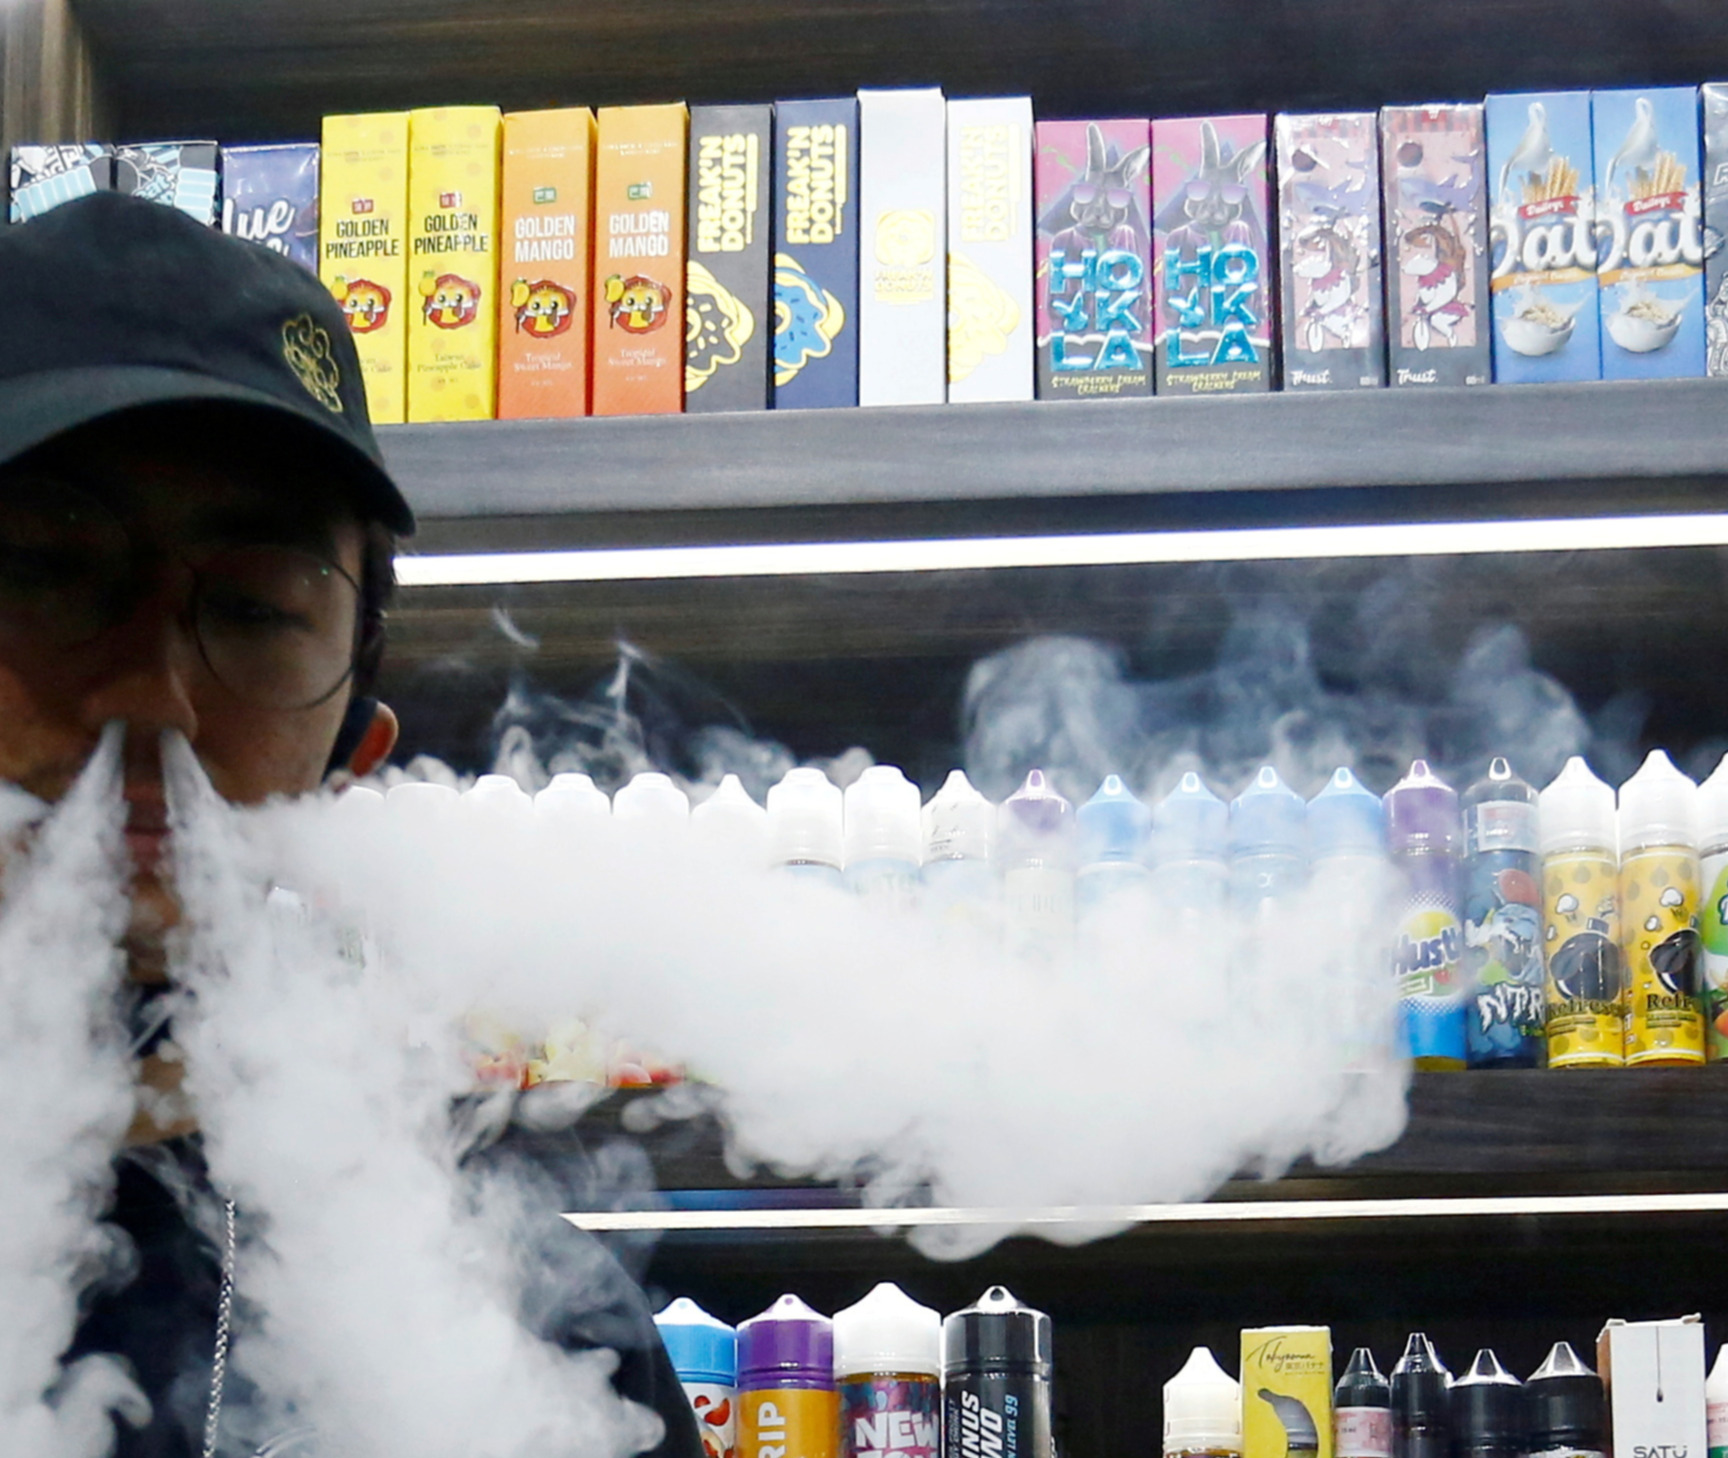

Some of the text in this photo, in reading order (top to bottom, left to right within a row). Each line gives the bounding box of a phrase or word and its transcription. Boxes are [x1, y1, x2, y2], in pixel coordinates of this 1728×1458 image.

[697, 136, 720, 252] FREAK'N
[722, 133, 745, 251] DONUTS
[787, 127, 810, 244] FREAK'N
[812, 124, 835, 242] DONUTS
[336, 218, 389, 238] GOLDEN
[424, 214, 478, 234] GOLDEN
[515, 216, 575, 238] GOLDEN
[609, 212, 669, 234] GOLDEN
[325, 238, 400, 259] PINEAPPLE
[414, 234, 489, 255] PINEAPPLE
[515, 239, 574, 262] MANGO
[609, 236, 668, 258] MANGO
[1050, 249, 1143, 293] HO
[1164, 244, 1259, 290] HO
[1051, 330, 1142, 371] LA
[1166, 322, 1259, 367] LA
[855, 1410, 939, 1450] NEW
